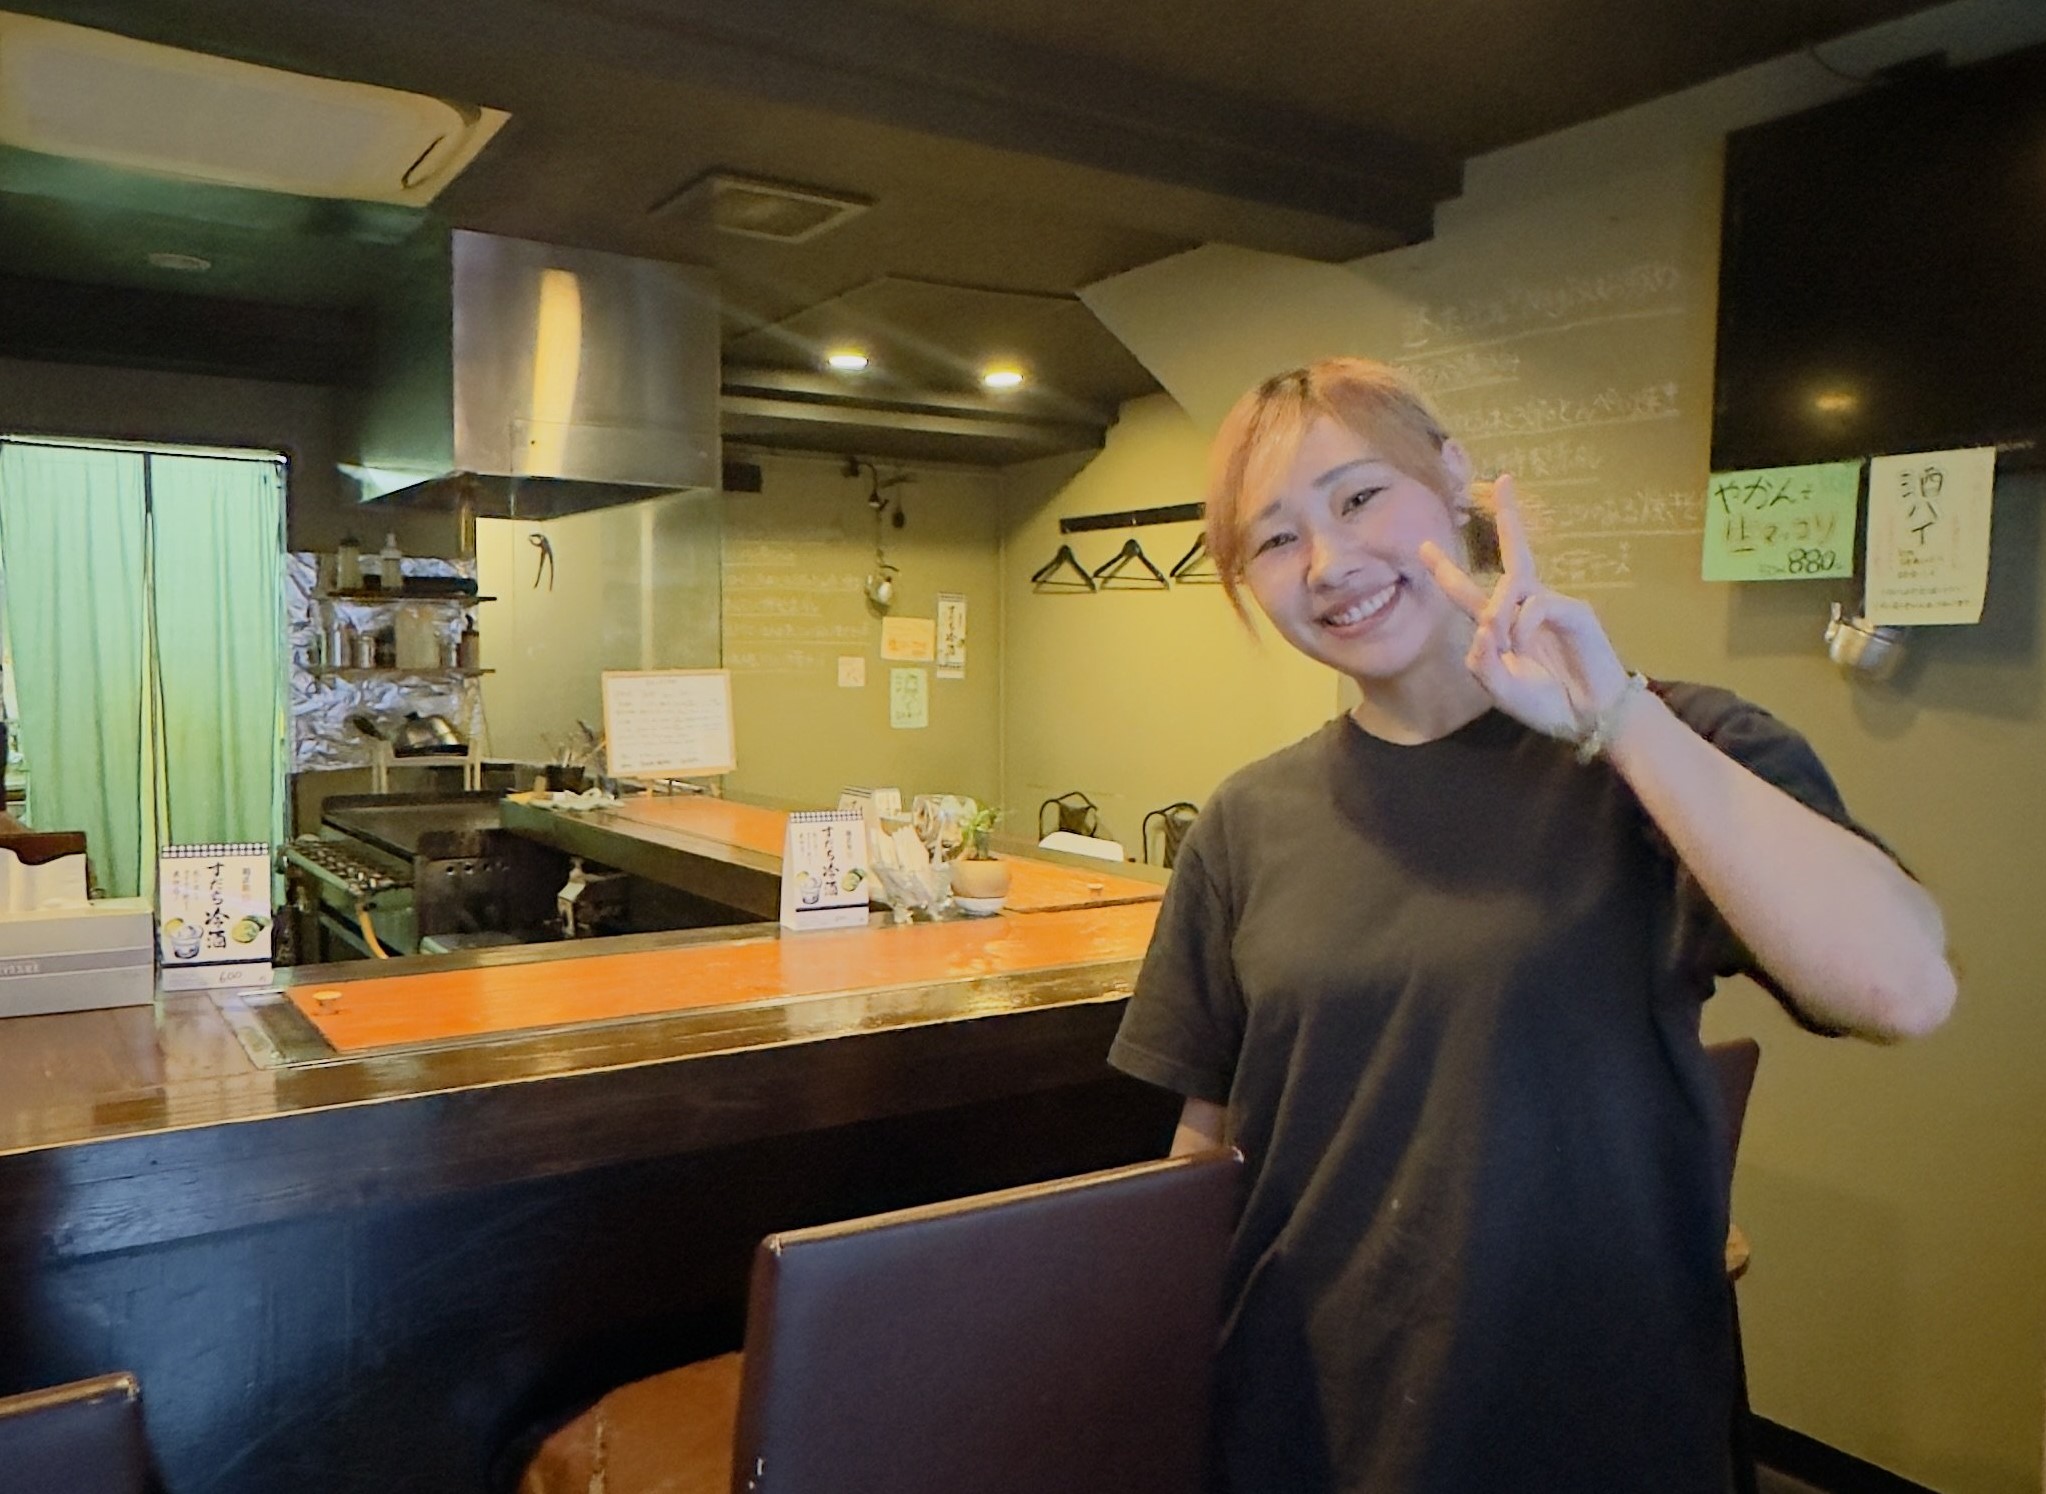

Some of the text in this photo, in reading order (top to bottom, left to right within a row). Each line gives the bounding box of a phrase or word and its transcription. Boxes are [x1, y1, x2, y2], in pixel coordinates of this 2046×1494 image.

[1787, 547, 1837, 574] 880
[203, 861, 231, 950] すだち冷酒
